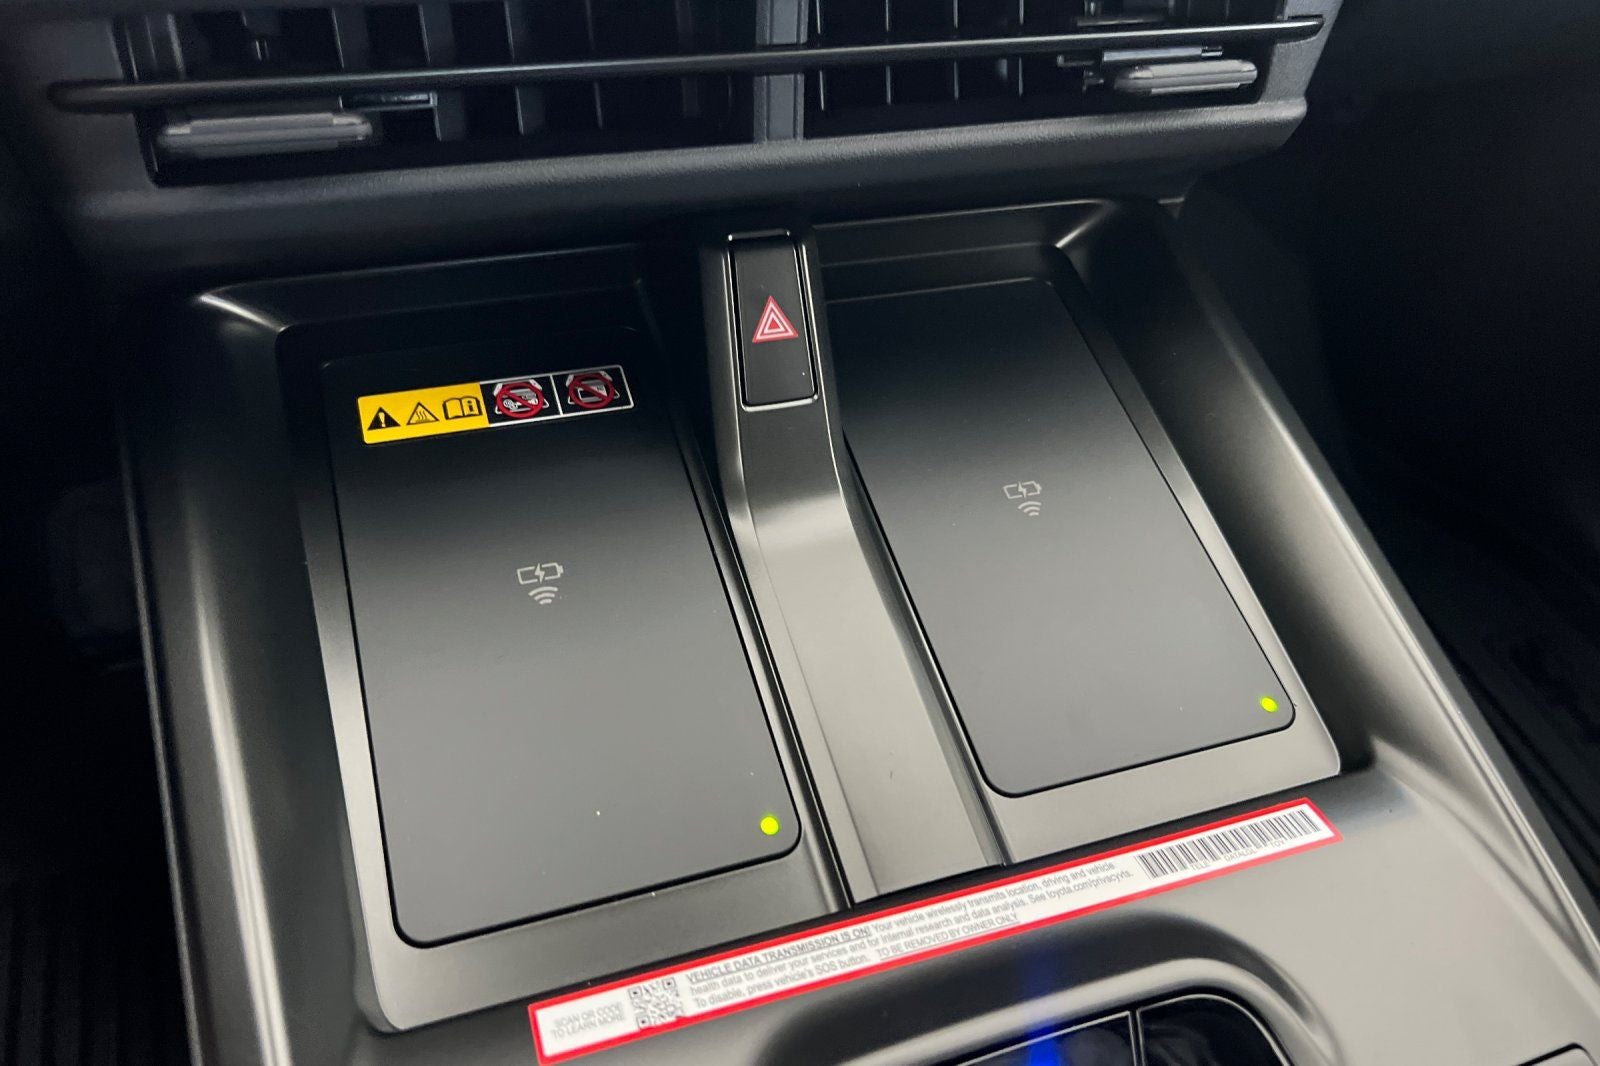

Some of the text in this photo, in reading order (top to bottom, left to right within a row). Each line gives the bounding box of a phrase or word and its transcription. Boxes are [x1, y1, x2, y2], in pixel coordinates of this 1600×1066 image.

[688, 963, 732, 982] VEHICLE
[734, 955, 762, 970] DATA
[762, 935, 840, 963] TRANSMISSION
[842, 932, 852, 941] IS
[854, 926, 872, 938] ON!
[873, 920, 895, 933] Your
[896, 912, 926, 927] vehicle
[926, 902, 968, 919] wirelessly
[968, 890, 1008, 908] transmits
[1043, 874, 1071, 888] driving
[1071, 869, 1088, 880] and
[1087, 862, 1116, 876] vehicle
[691, 979, 720, 995] health
[722, 973, 743, 987] data
[745, 970, 755, 980] to
[756, 962, 787, 977] deliver
[789, 958, 810, 970] your
[811, 946, 849, 963] services
[850, 940, 867, 952] and
[868, 936, 881, 947] for
[882, 927, 915, 943] internal
[916, 917, 954, 934] research
[955, 912, 971, 924] and
[972, 907, 992, 919] data
[992, 897, 1030, 914] analysis.
[1029, 892, 1047, 903] See
[878, 912, 1019, 957] TO BE REMOVED BY OWNER ONLY
[695, 996, 708, 1008] To
[748, 980, 774, 995] press
[775, 967, 815, 986] vehicle's
[816, 961, 838, 975] SOS
[839, 952, 872, 968] button.
[552, 1011, 627, 1039] TO LEARN MORE
